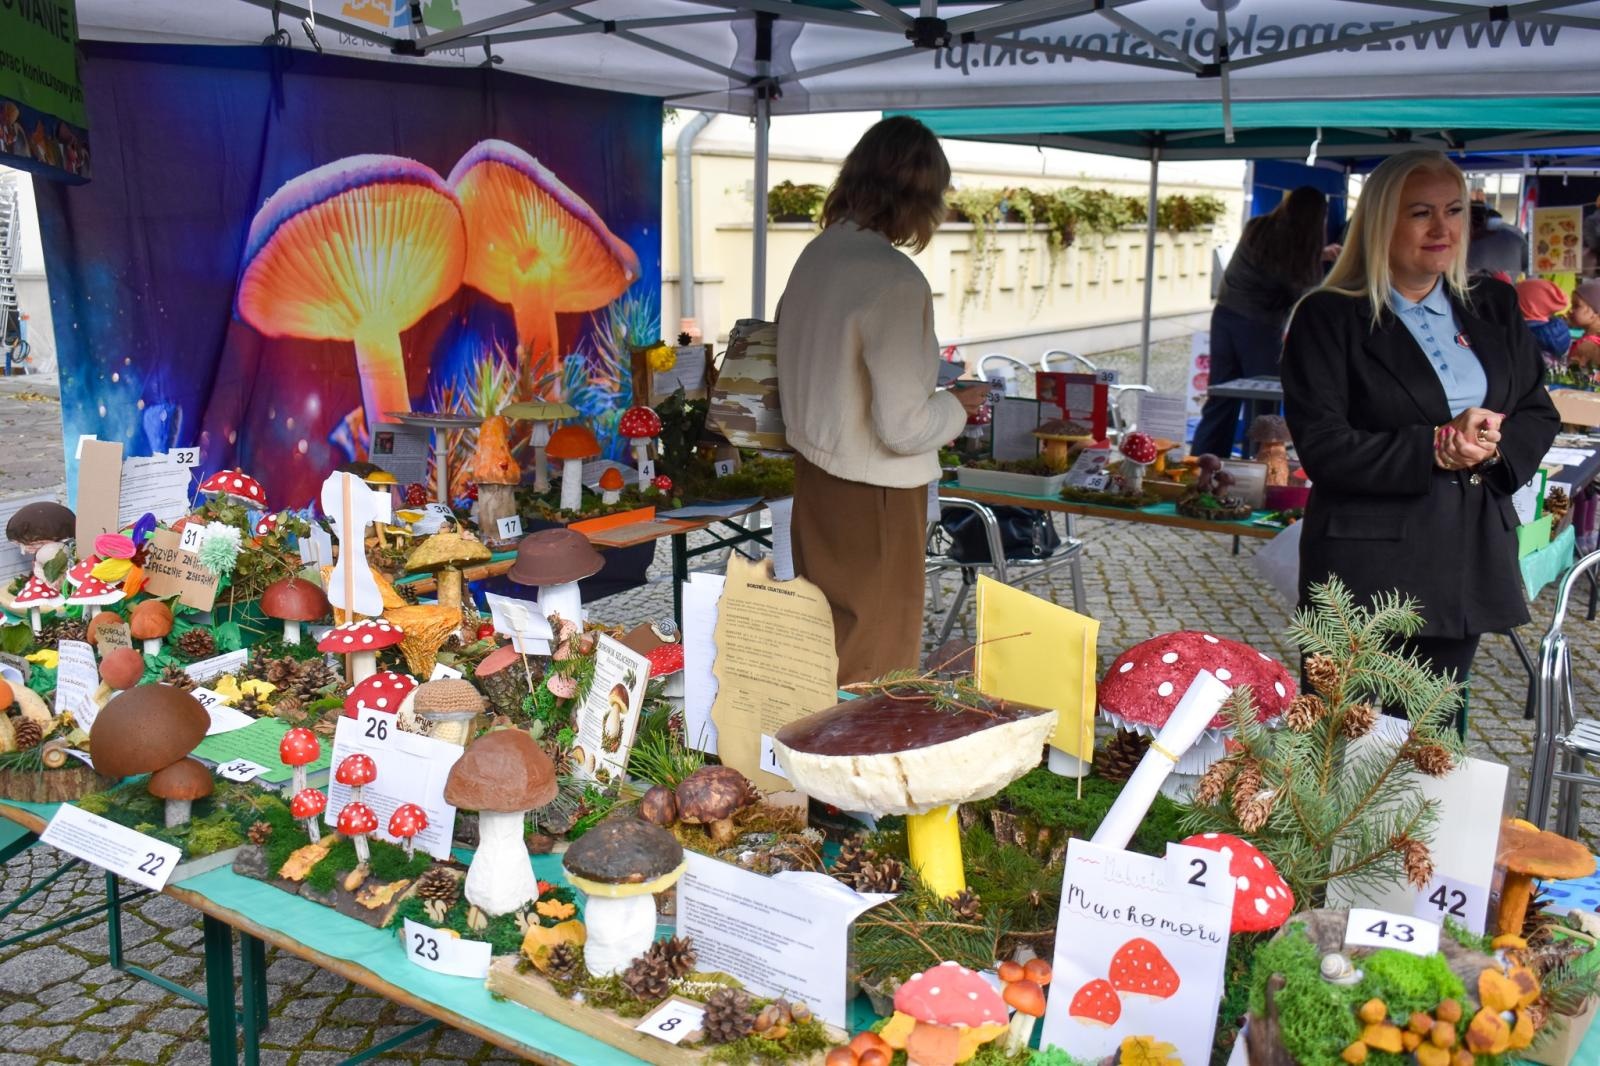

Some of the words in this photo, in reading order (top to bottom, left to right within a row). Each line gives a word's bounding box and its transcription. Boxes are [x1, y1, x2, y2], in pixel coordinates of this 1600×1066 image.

[3, 0, 70, 43] WANIE
[1101, 371, 1114, 382] 39
[176, 452, 194, 464] 32
[642, 465, 649, 476] 4
[721, 464, 728, 474] 9
[504, 520, 517, 534] 17
[184, 529, 198, 546] 31
[365, 717, 388, 741] 26
[227, 761, 256, 776] 34
[137, 852, 165, 876] 22
[1188, 858, 1208, 887] 2
[1428, 885, 1467, 918] 42
[1366, 920, 1415, 943] 43
[414, 933, 440, 961] 23
[658, 1017, 682, 1031] 8
